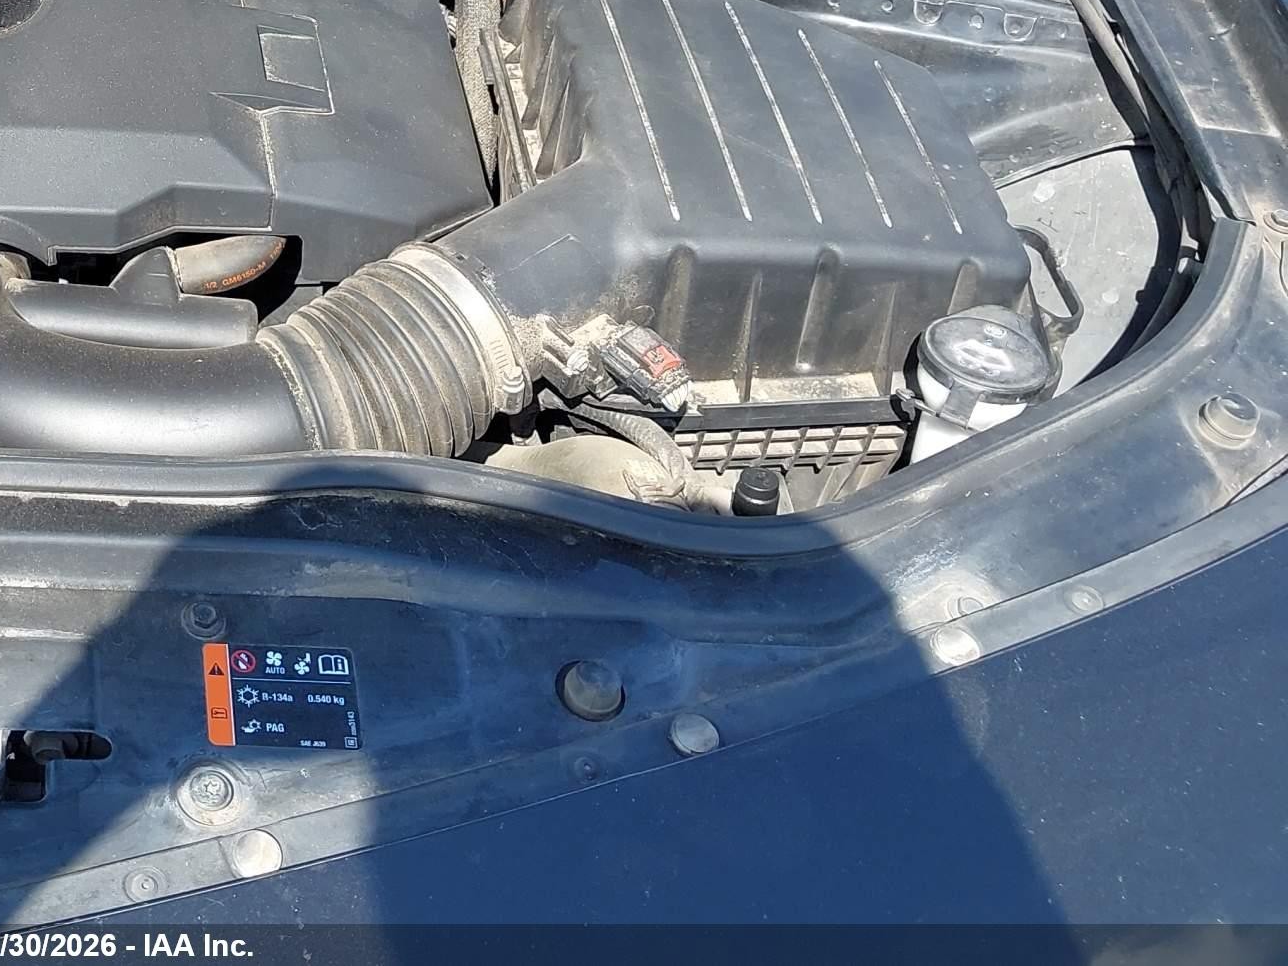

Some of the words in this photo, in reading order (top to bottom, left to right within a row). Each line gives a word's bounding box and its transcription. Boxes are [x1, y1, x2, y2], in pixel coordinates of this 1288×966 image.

[265, 666, 285, 675] AUTO
[261, 692, 293, 702] R-134a
[307, 694, 332, 704] 0.540
[333, 695, 345, 706] kg
[266, 723, 285, 733] PAG
